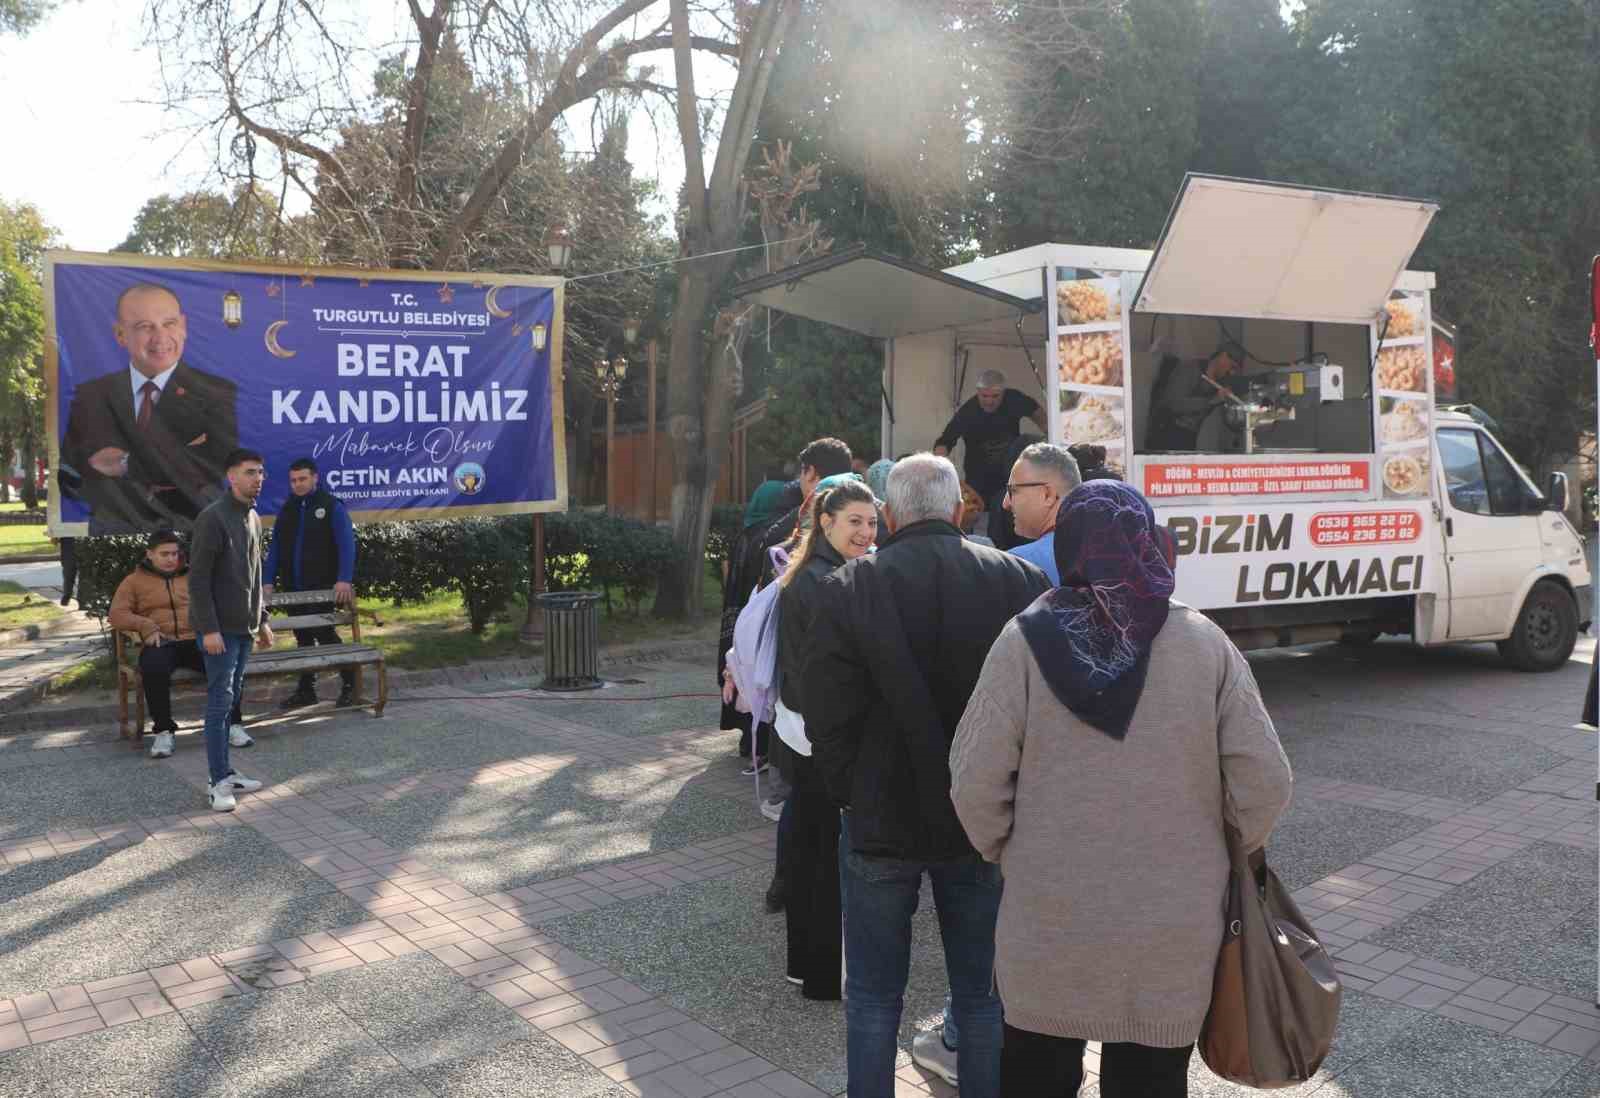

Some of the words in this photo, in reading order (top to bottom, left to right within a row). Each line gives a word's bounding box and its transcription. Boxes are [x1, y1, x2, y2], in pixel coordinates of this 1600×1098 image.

[391, 293, 419, 307] T.C.
[313, 308, 400, 324] TURGUTLU
[404, 311, 491, 327] BELEDİYESİ
[337, 343, 470, 377] BERAT
[271, 381, 529, 424] KANDİLİMİZ
[422, 426, 496, 464] Olsun
[326, 465, 389, 489] ÇETİN
[396, 467, 448, 484] AKIN
[371, 487, 412, 499] BELEDİYE
[1399, 514, 1414, 525] 07
[1317, 531, 1349, 543] 0554
[1353, 529, 1376, 541] 236
[1380, 528, 1395, 540] 50
[1235, 555, 1423, 603] LOKMACI
